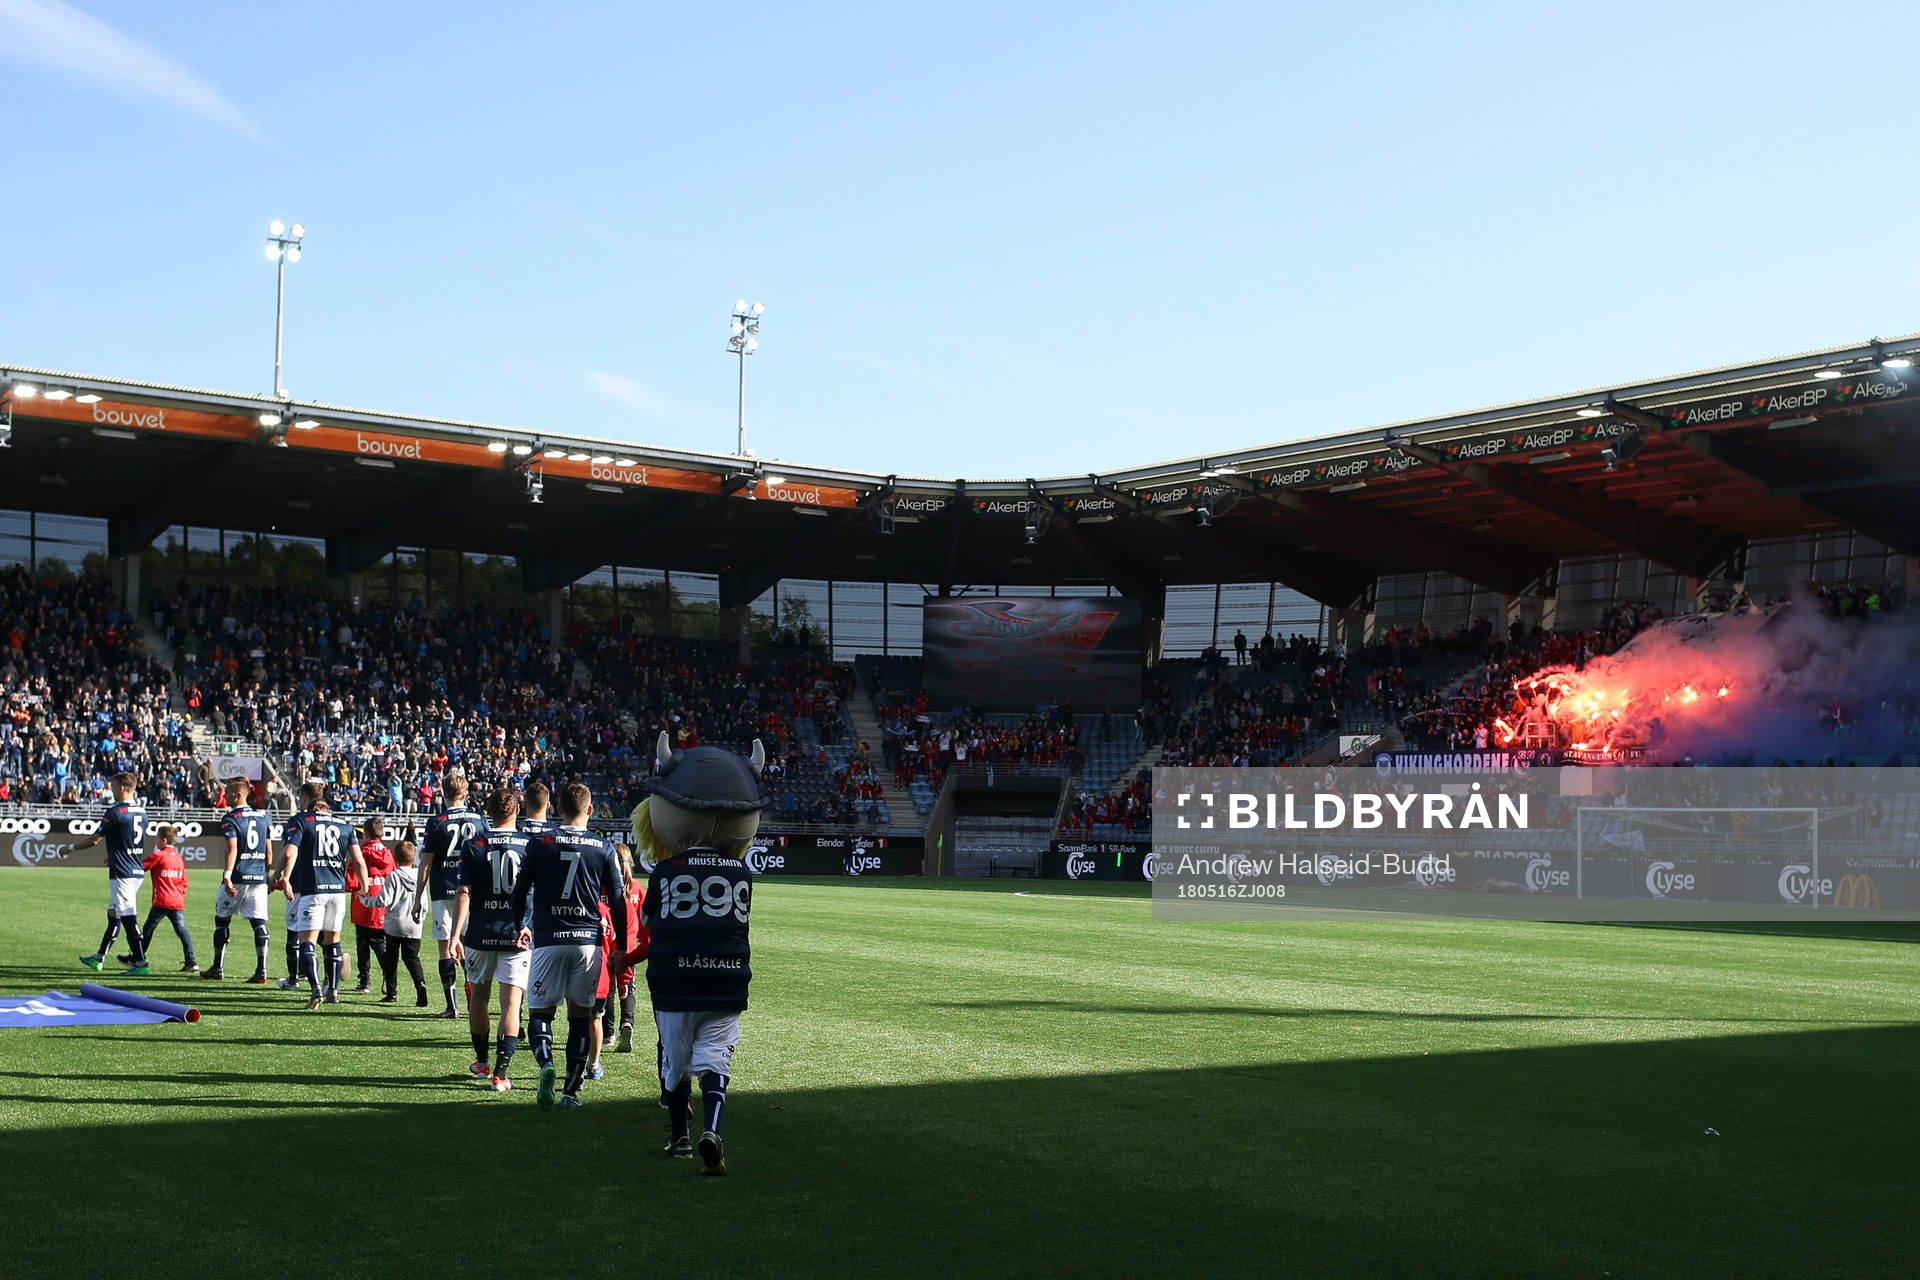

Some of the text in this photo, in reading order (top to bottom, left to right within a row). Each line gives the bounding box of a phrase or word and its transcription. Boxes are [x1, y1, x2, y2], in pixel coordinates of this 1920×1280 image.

[1767, 388, 1827, 412] AkerBP
[1853, 381, 1908, 400] Ake
[93, 403, 165, 430] bouvet
[1686, 402, 1743, 424] AkerBP
[357, 434, 421, 459] bouvet
[1524, 428, 1574, 448] AkerBP
[1458, 439, 1506, 459] AkerBP
[591, 463, 648, 485] bouvet
[1270, 469, 1310, 486] AkerBP
[1327, 460, 1368, 478] AkerBP
[767, 485, 820, 504] bouvet
[1151, 488, 1188, 505] AkerBP
[896, 499, 945, 512] AkerBP
[1395, 753, 1509, 775] VIKINGHORDENE
[133, 815, 143, 845] 5
[146, 820, 202, 837] cop
[246, 819, 259, 850] 6
[315, 824, 341, 857] 18
[511, 838, 529, 847] SMIT
[487, 850, 521, 894] 10
[688, 857, 743, 868] KRUSE SMITH
[754, 854, 785, 870] Lyse
[852, 855, 881, 871] Lyse
[1073, 860, 1095, 875] Lyse
[1149, 861, 1173, 877] Lyse
[560, 851, 581, 899] 7
[1535, 867, 1569, 890] Lyse
[1657, 870, 1695, 893] Lyse
[660, 874, 749, 924] 1899
[551, 906, 586, 917] BYTYQI
[678, 953, 741, 969] BLÅSKALLE
